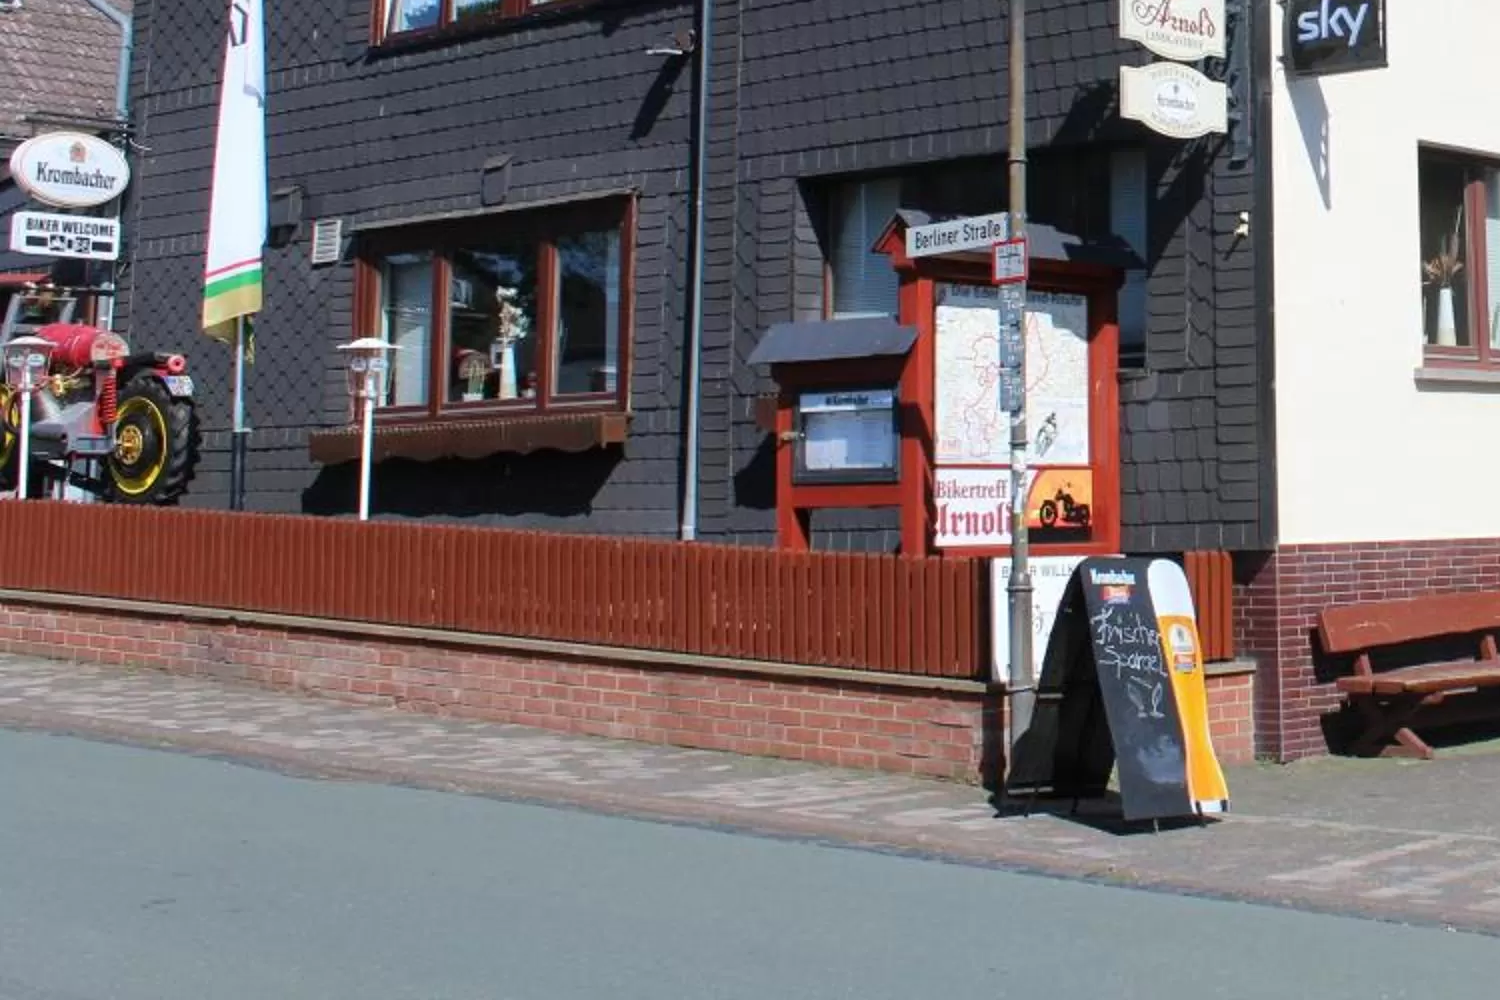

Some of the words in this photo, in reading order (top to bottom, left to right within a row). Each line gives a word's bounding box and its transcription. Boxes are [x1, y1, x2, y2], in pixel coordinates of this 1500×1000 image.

[36, 161, 117, 190] Krombacher
[26, 217, 60, 233] BIKER
[62, 220, 116, 237] WELCOME
[915, 229, 959, 249] Berliner
[962, 219, 1001, 242] Straße
[936, 478, 1009, 499] Bikertreff
